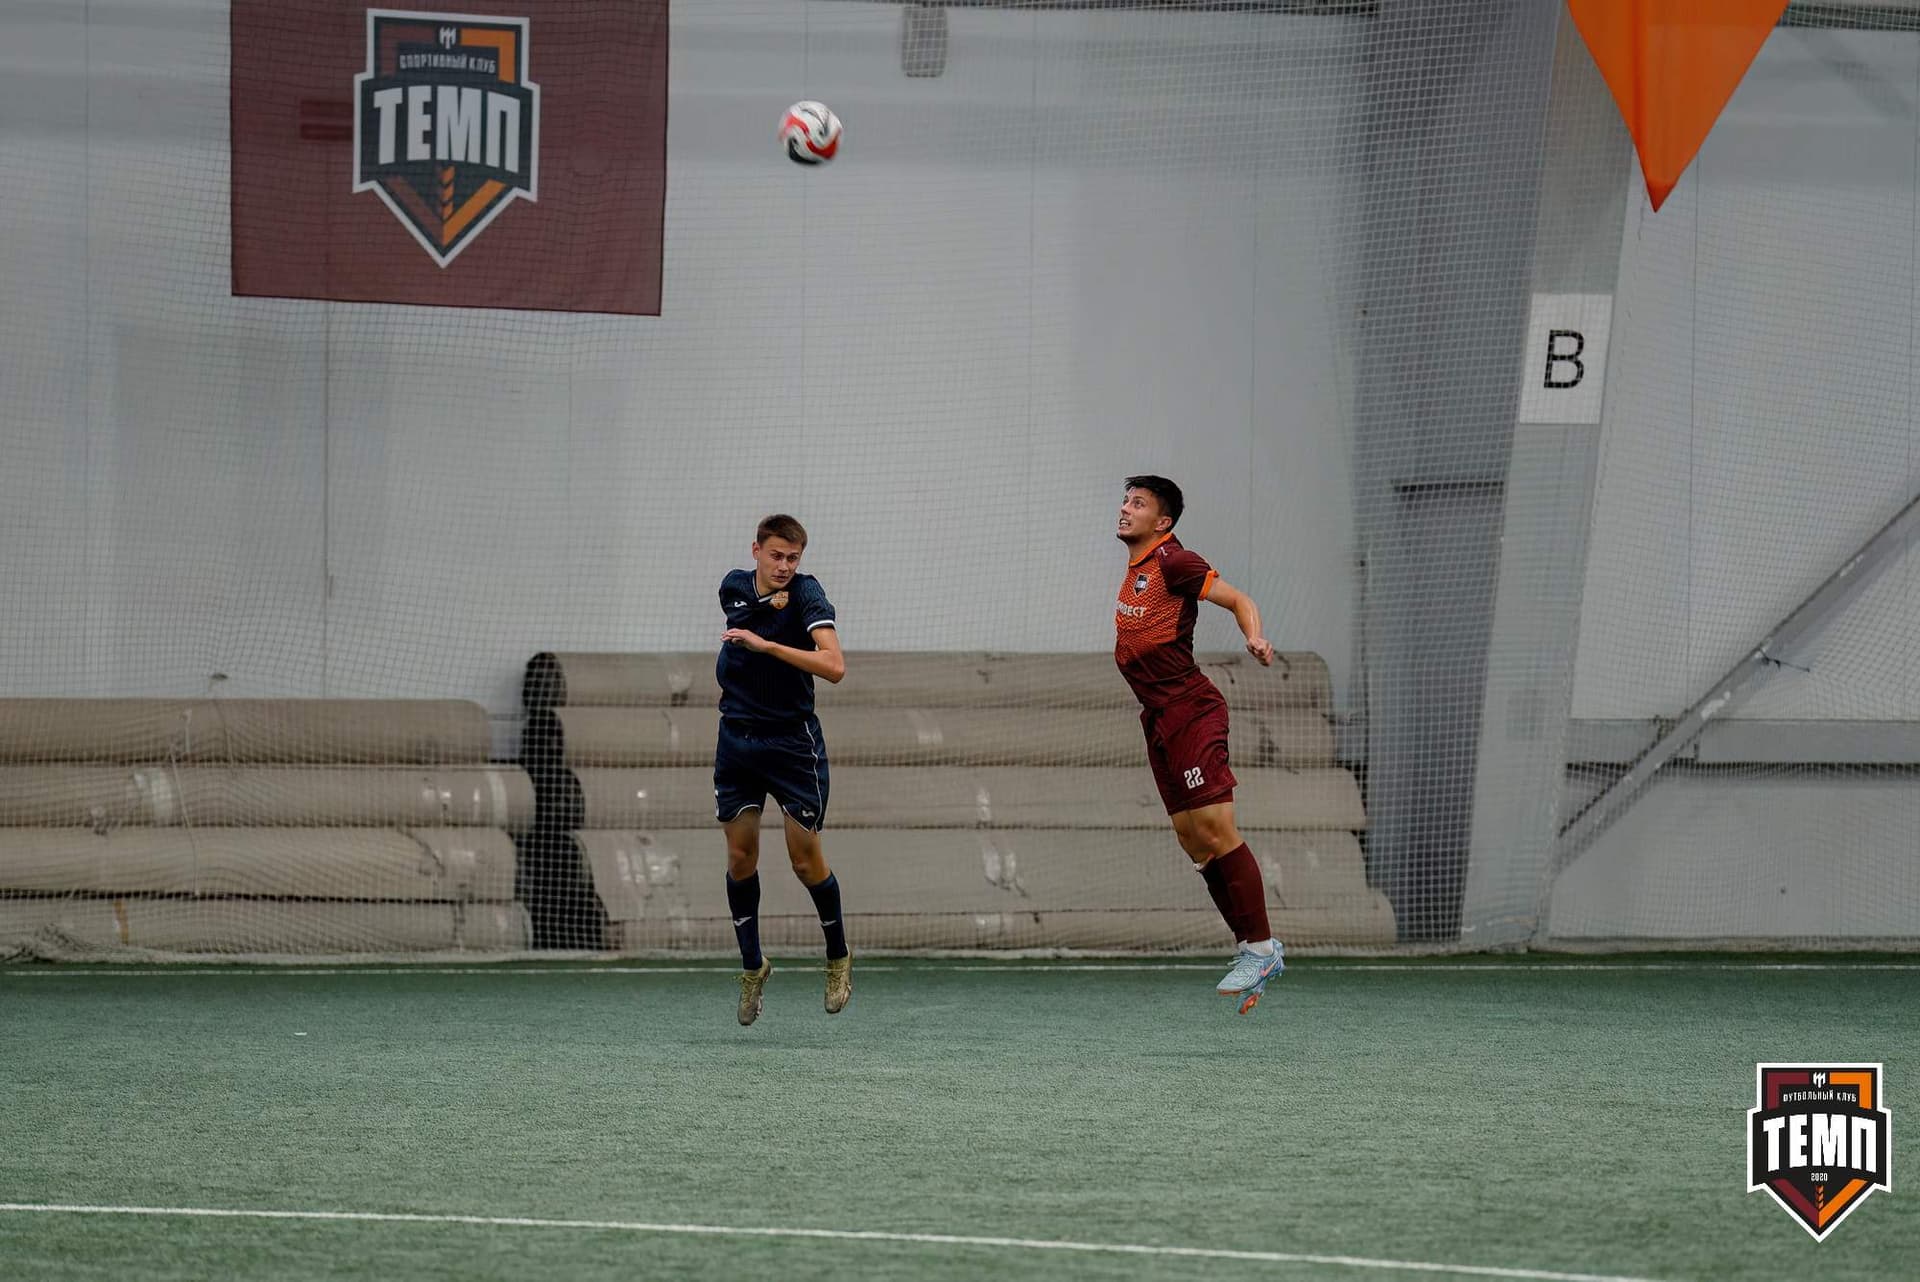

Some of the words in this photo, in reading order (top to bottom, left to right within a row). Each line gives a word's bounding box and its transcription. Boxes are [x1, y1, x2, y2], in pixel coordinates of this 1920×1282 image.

[468, 57, 497, 74] КЛУБ
[373, 85, 521, 174] ТЕМП
[1183, 766, 1205, 790] 22
